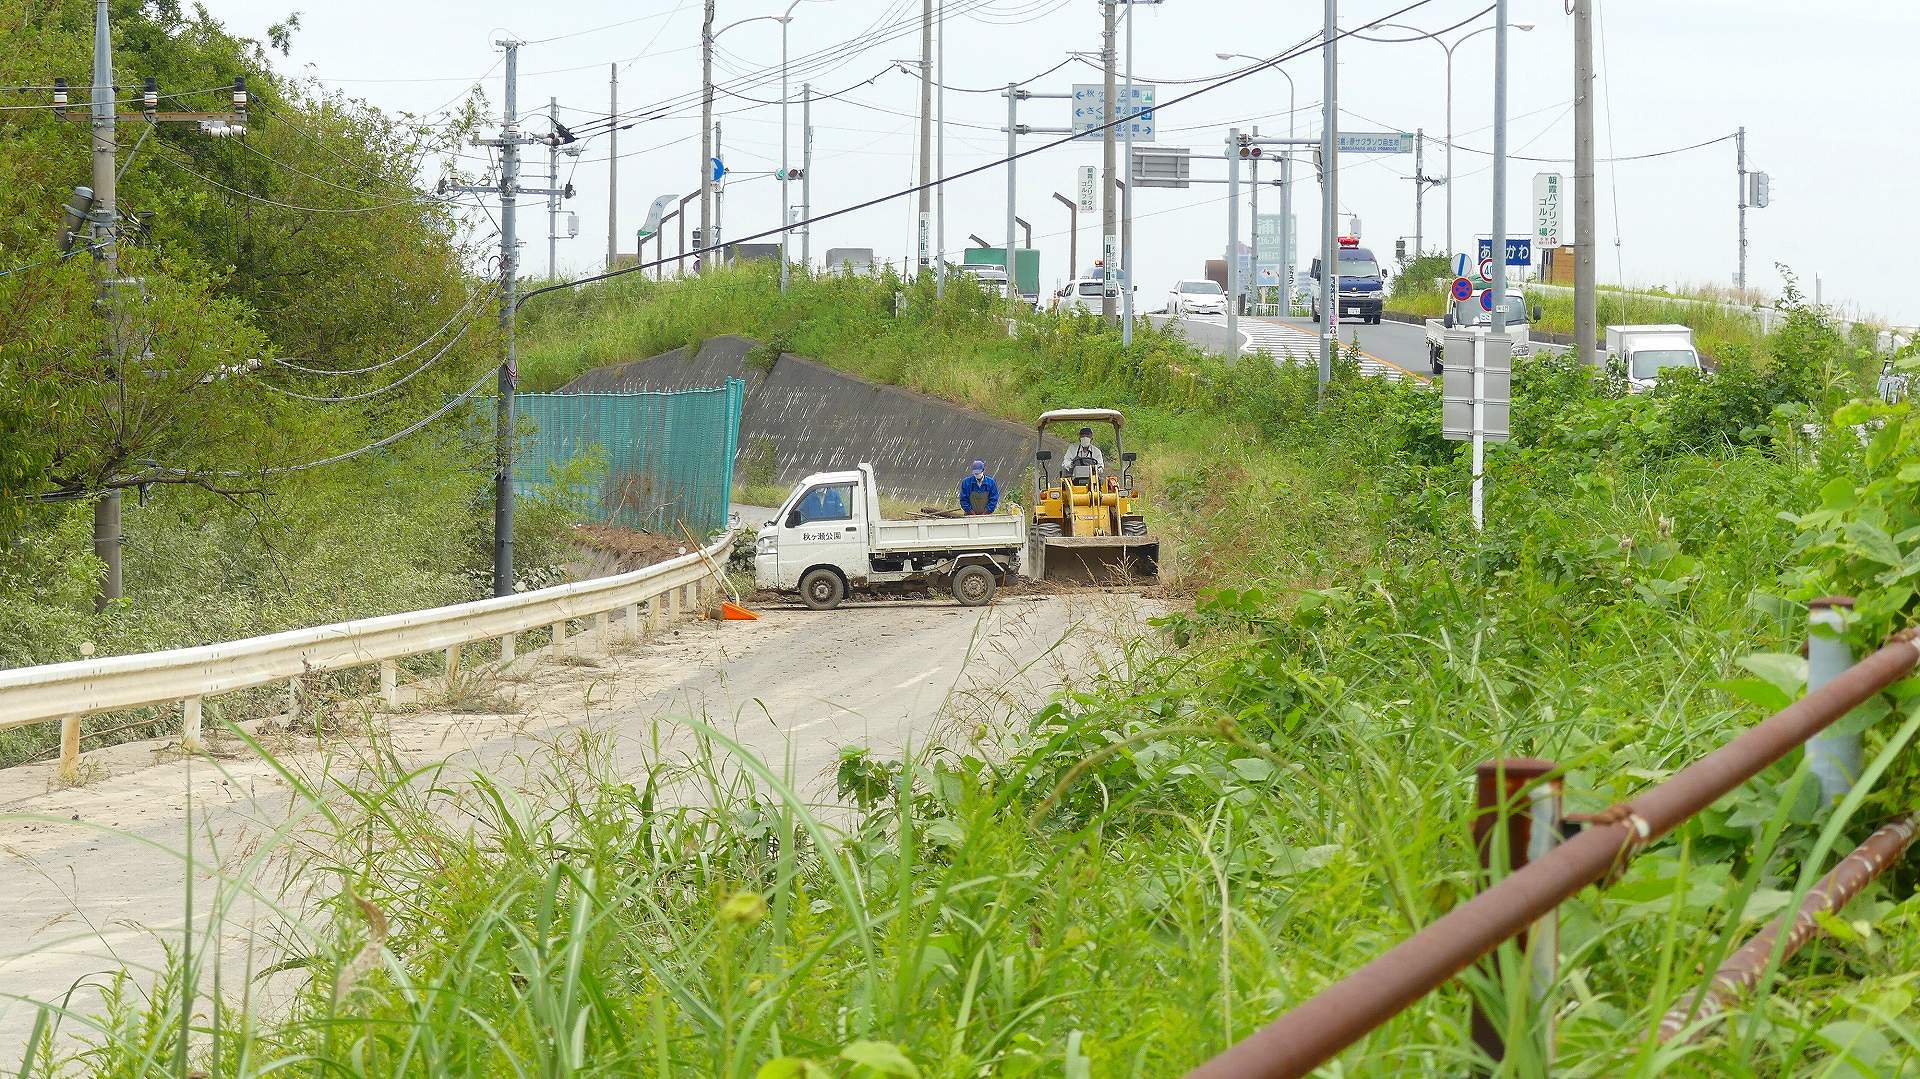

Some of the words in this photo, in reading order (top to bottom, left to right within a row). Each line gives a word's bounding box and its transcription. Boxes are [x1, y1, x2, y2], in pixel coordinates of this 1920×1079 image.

[1538, 197, 1548, 237] ゴルフ場
[1481, 245, 1529, 260] あかわ
